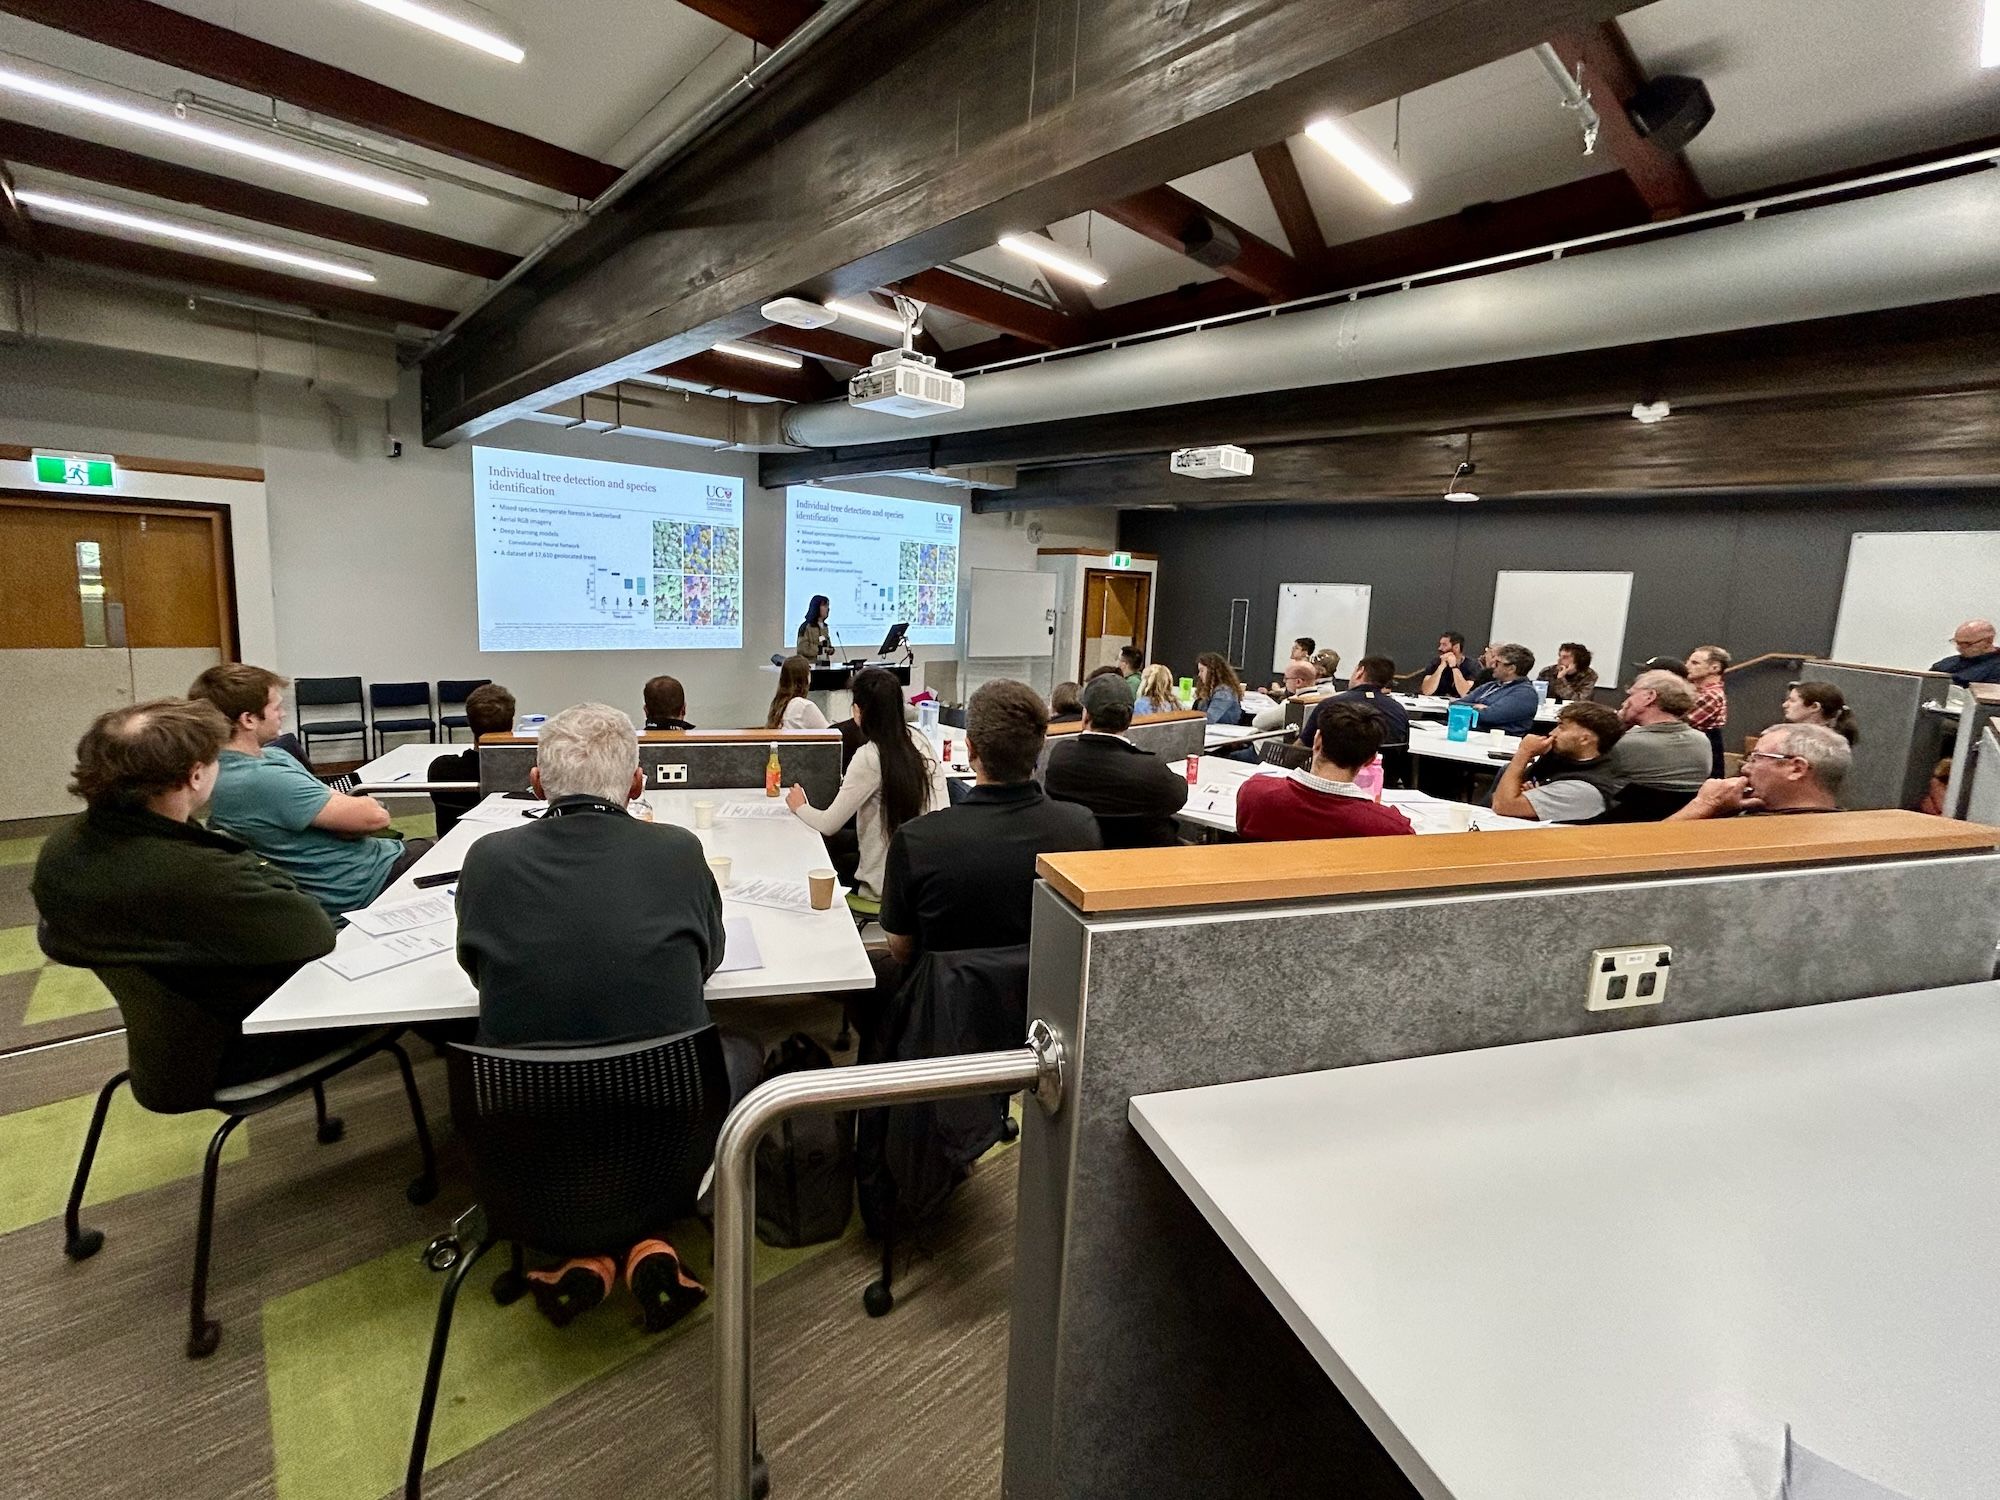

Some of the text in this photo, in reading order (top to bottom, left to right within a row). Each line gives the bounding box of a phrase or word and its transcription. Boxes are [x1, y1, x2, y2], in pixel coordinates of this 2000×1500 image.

[488, 466, 657, 493] Individual tree detection and species
[489, 480, 555, 496] identification
[706, 485, 725, 498] UC
[518, 506, 538, 514] species
[796, 499, 904, 520] Individual tree detection and species
[796, 511, 838, 523] identification
[516, 529, 538, 537] learning
